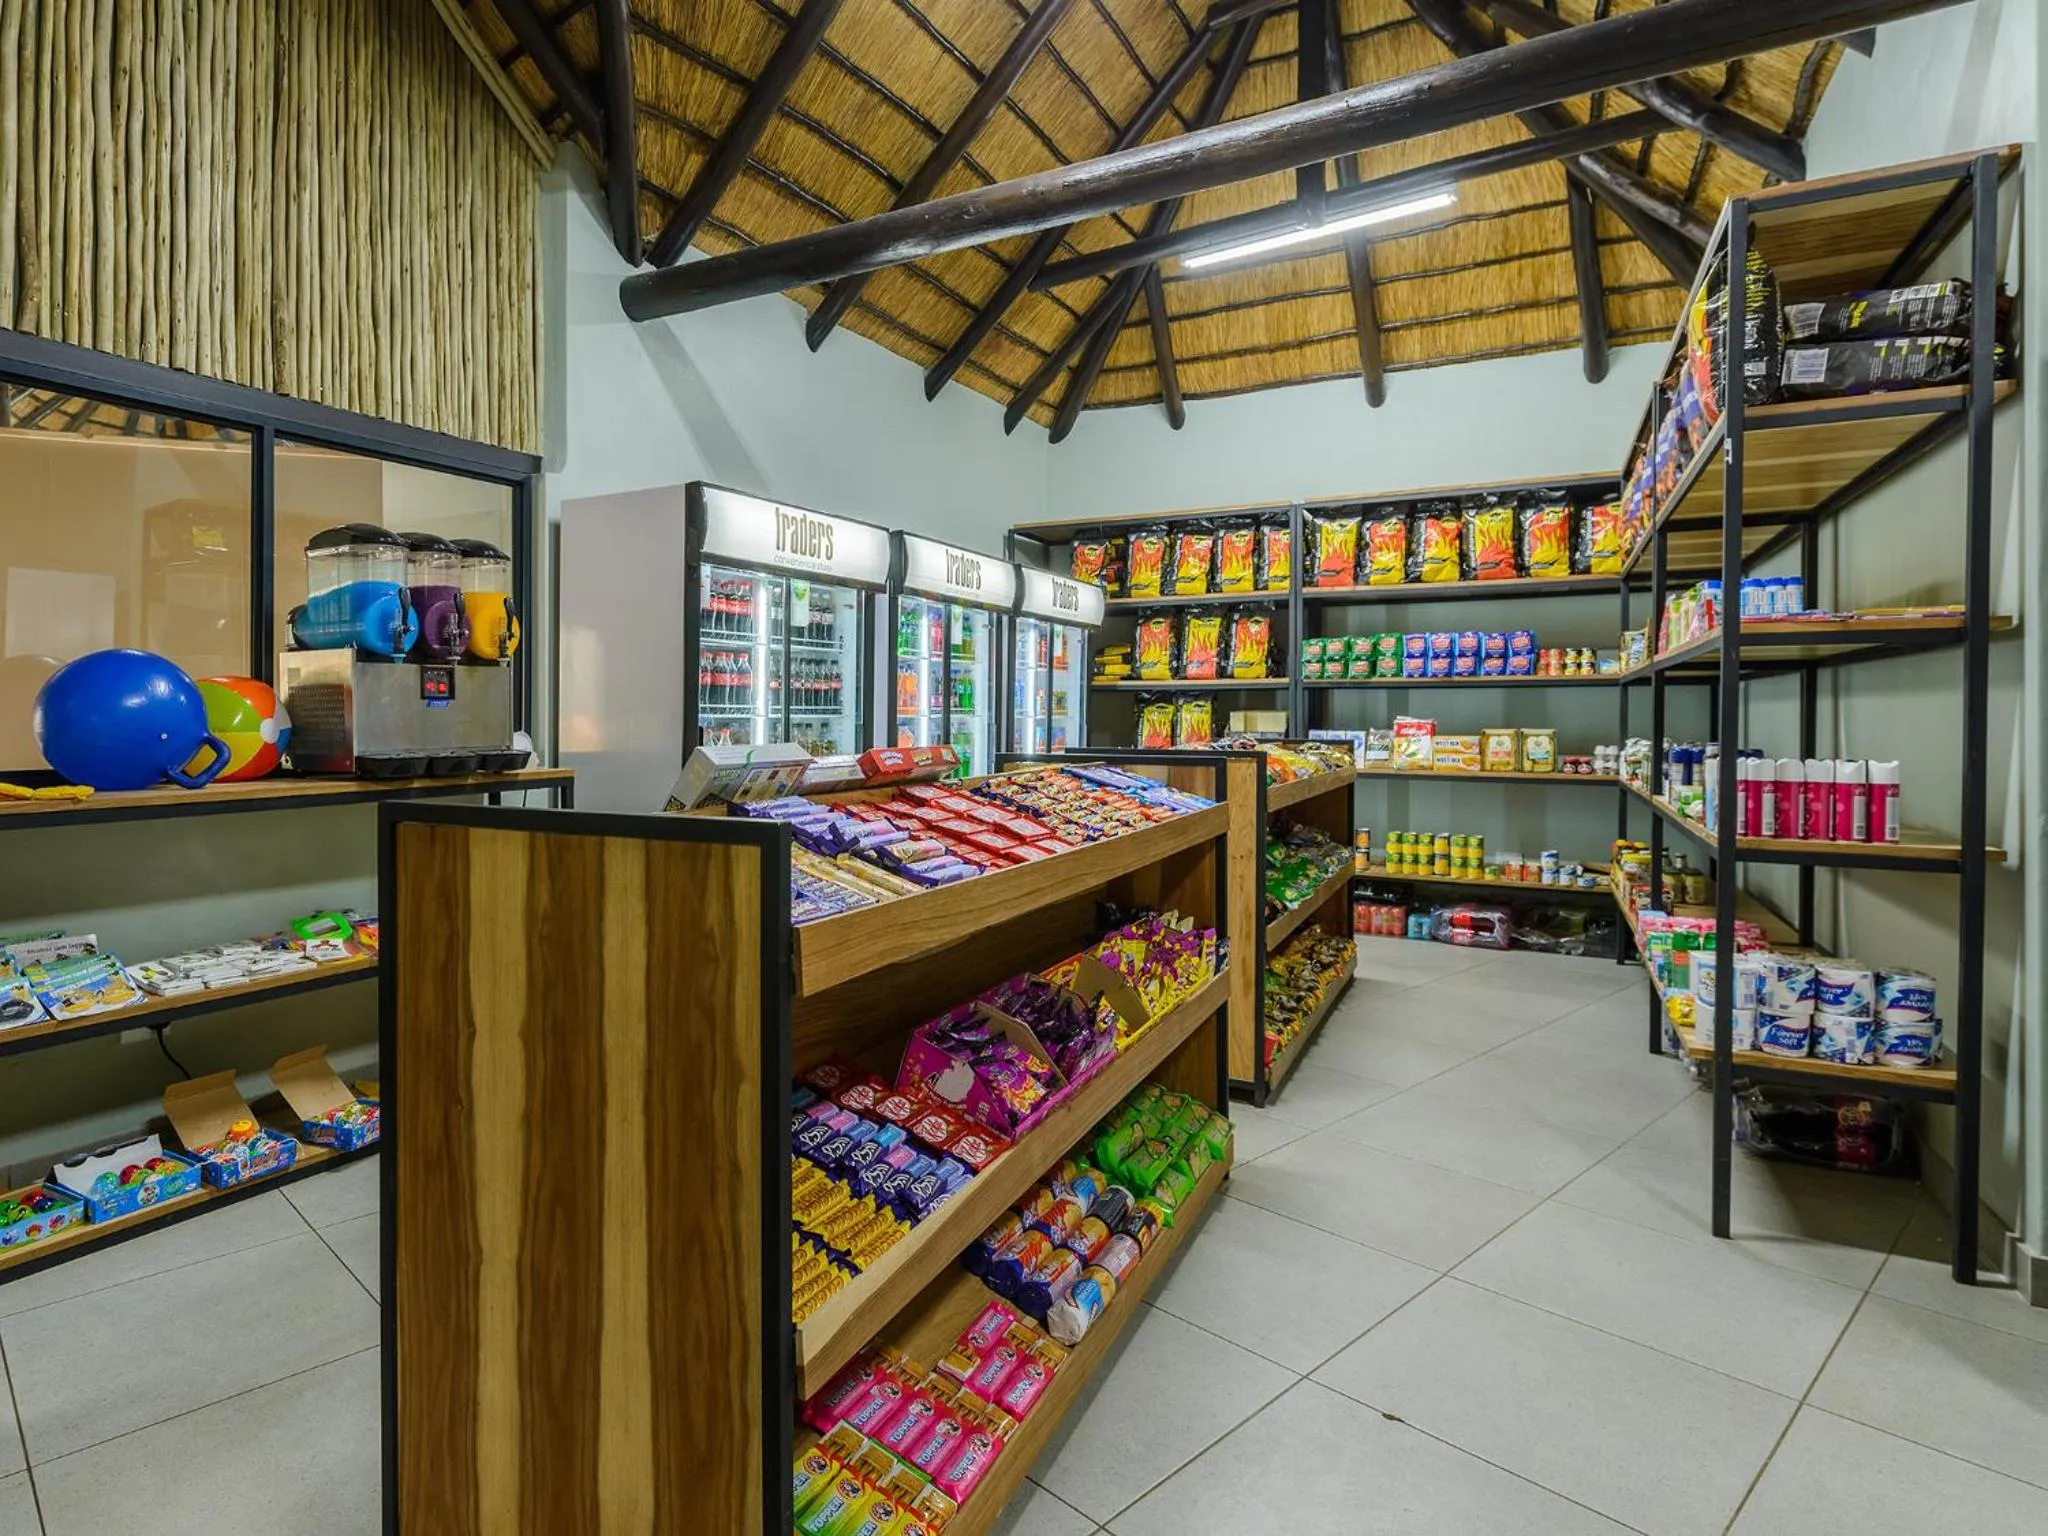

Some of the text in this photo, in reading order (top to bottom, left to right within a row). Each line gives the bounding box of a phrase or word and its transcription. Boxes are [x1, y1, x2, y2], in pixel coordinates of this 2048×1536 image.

[852, 1397, 885, 1427] TOPPER
[889, 1414, 918, 1444] TOPPER
[915, 1434, 946, 1465] TOPPER
[949, 1450, 977, 1482] TOPPER
[807, 1495, 845, 1532] TOPPER
